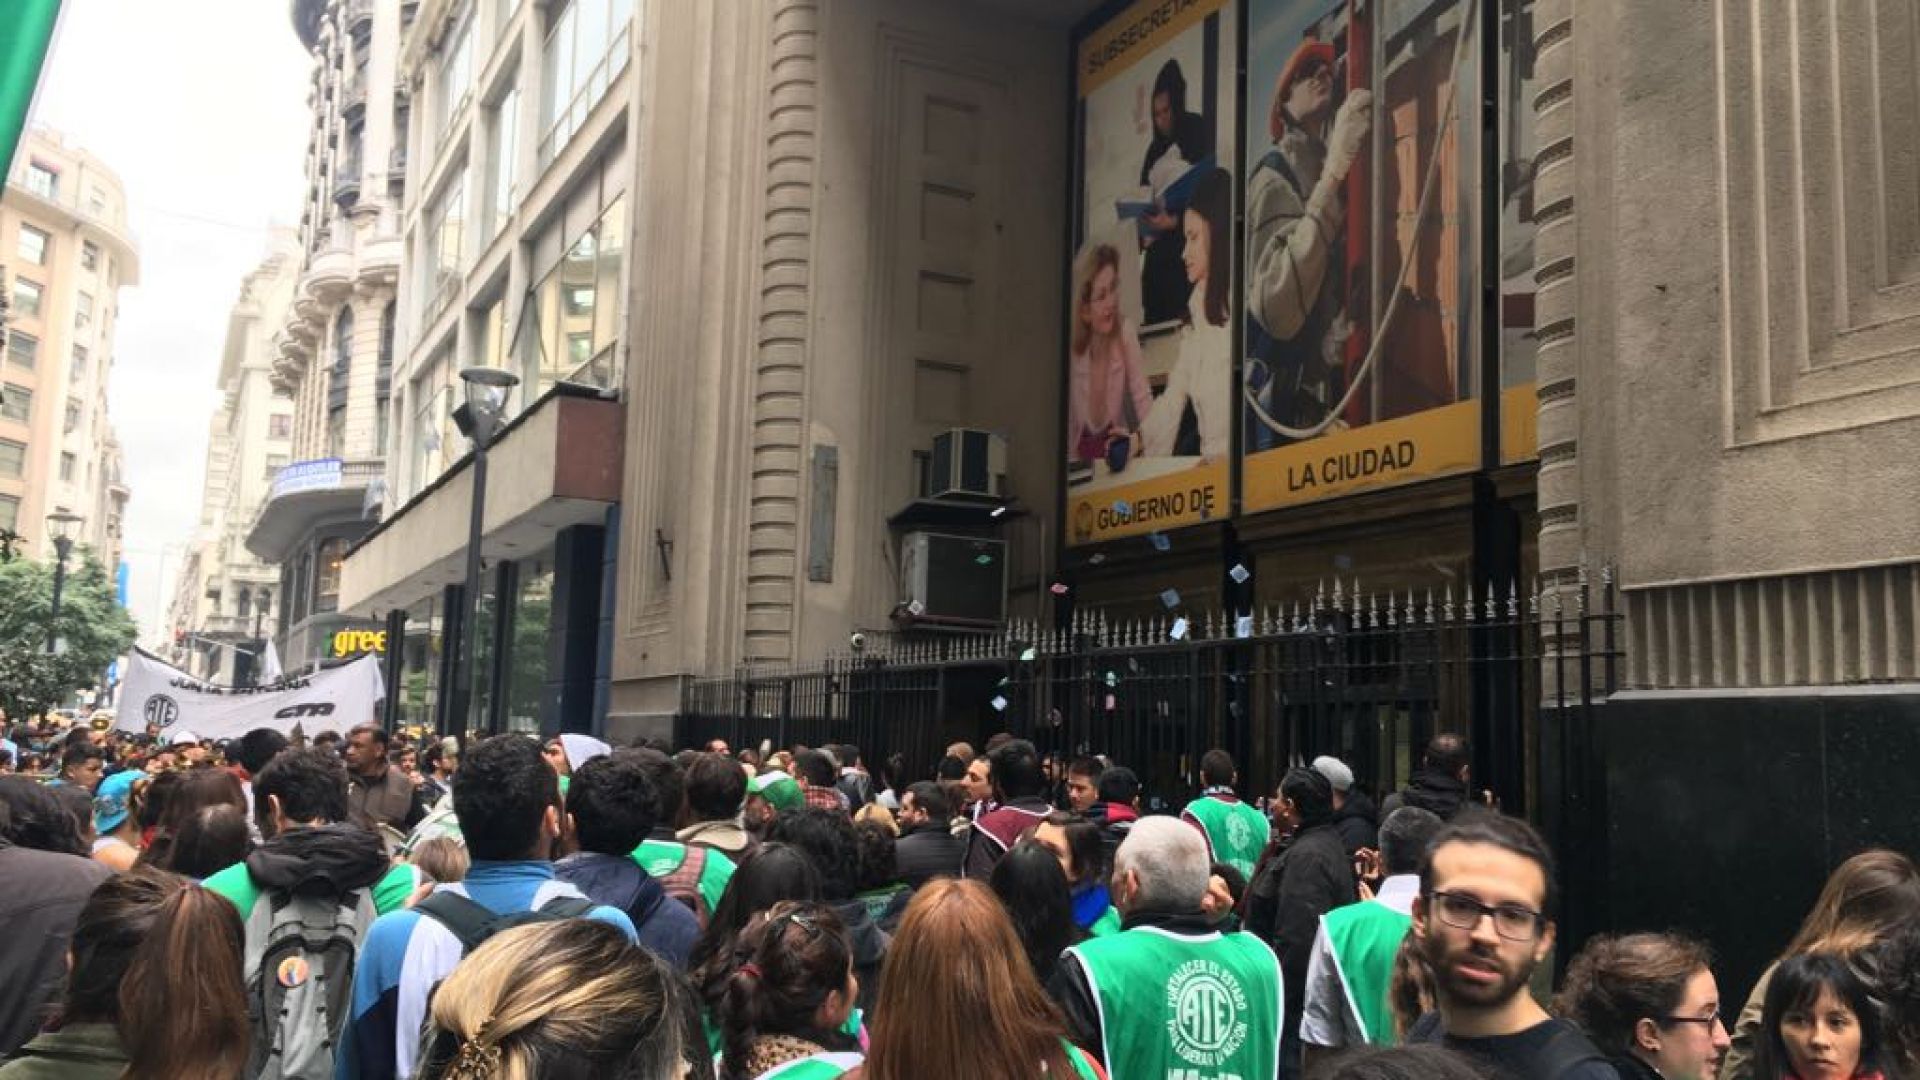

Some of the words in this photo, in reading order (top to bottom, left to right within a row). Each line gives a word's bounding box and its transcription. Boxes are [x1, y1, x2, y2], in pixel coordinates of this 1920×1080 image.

[1288, 463, 1317, 492] LA
[1321, 440, 1415, 484] CIUDAD
[1190, 485, 1215, 513] DE
[1181, 983, 1229, 1046] ATE
